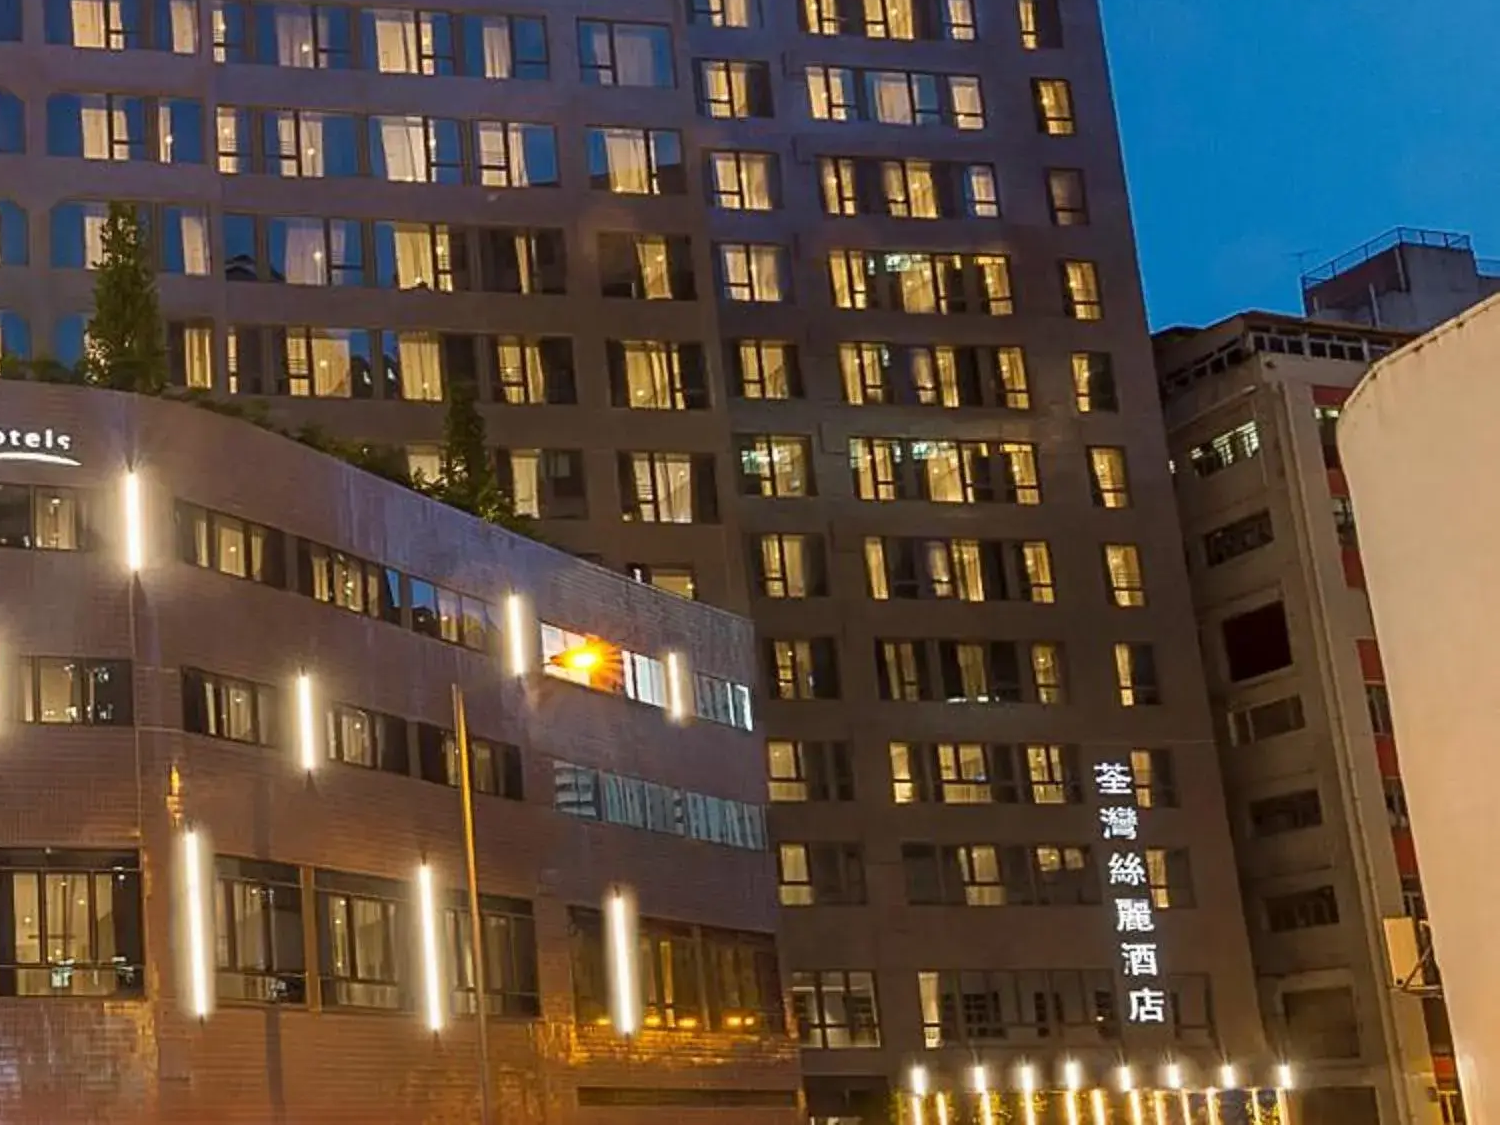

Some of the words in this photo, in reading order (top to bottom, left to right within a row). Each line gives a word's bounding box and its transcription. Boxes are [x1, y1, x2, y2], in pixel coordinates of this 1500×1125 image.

[1093, 761, 1165, 1023] 荃灣絲麗酒店
